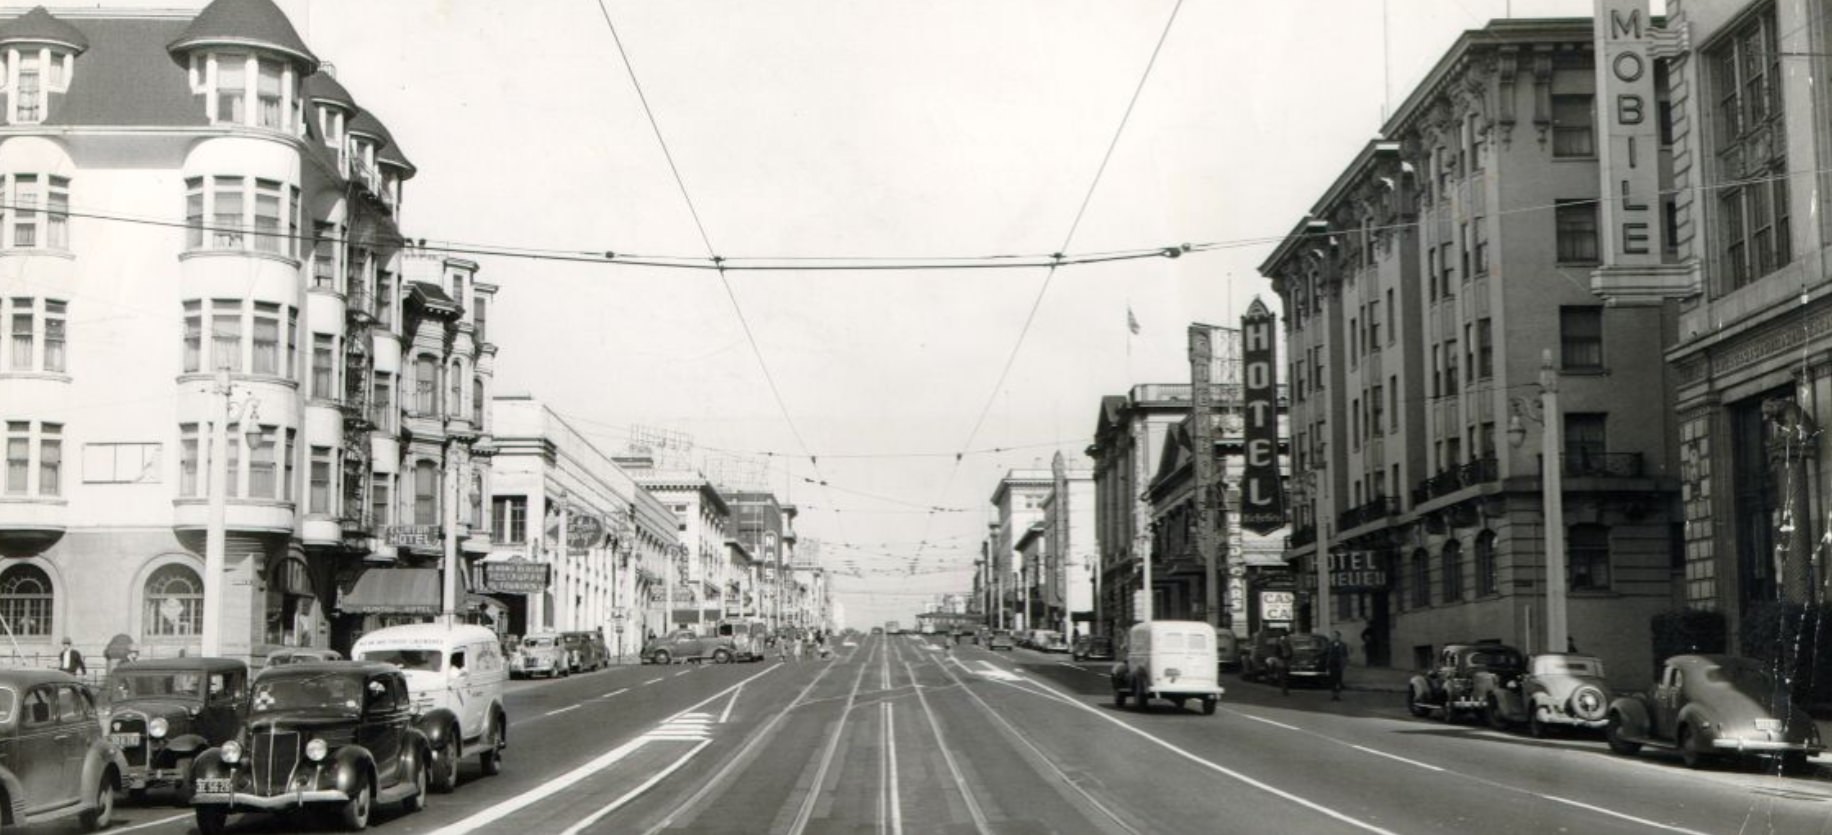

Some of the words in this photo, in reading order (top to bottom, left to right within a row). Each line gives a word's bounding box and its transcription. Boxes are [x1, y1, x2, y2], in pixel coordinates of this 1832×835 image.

[1610, 8, 1650, 255] MOBILE
[1246, 322, 1272, 506] HOTEL
[389, 534, 432, 545] HOTEL
[1228, 513, 1242, 556] USED
[764, 535, 776, 580] NAS
[1230, 566, 1244, 611] CARS
[1263, 594, 1293, 604] CAS
